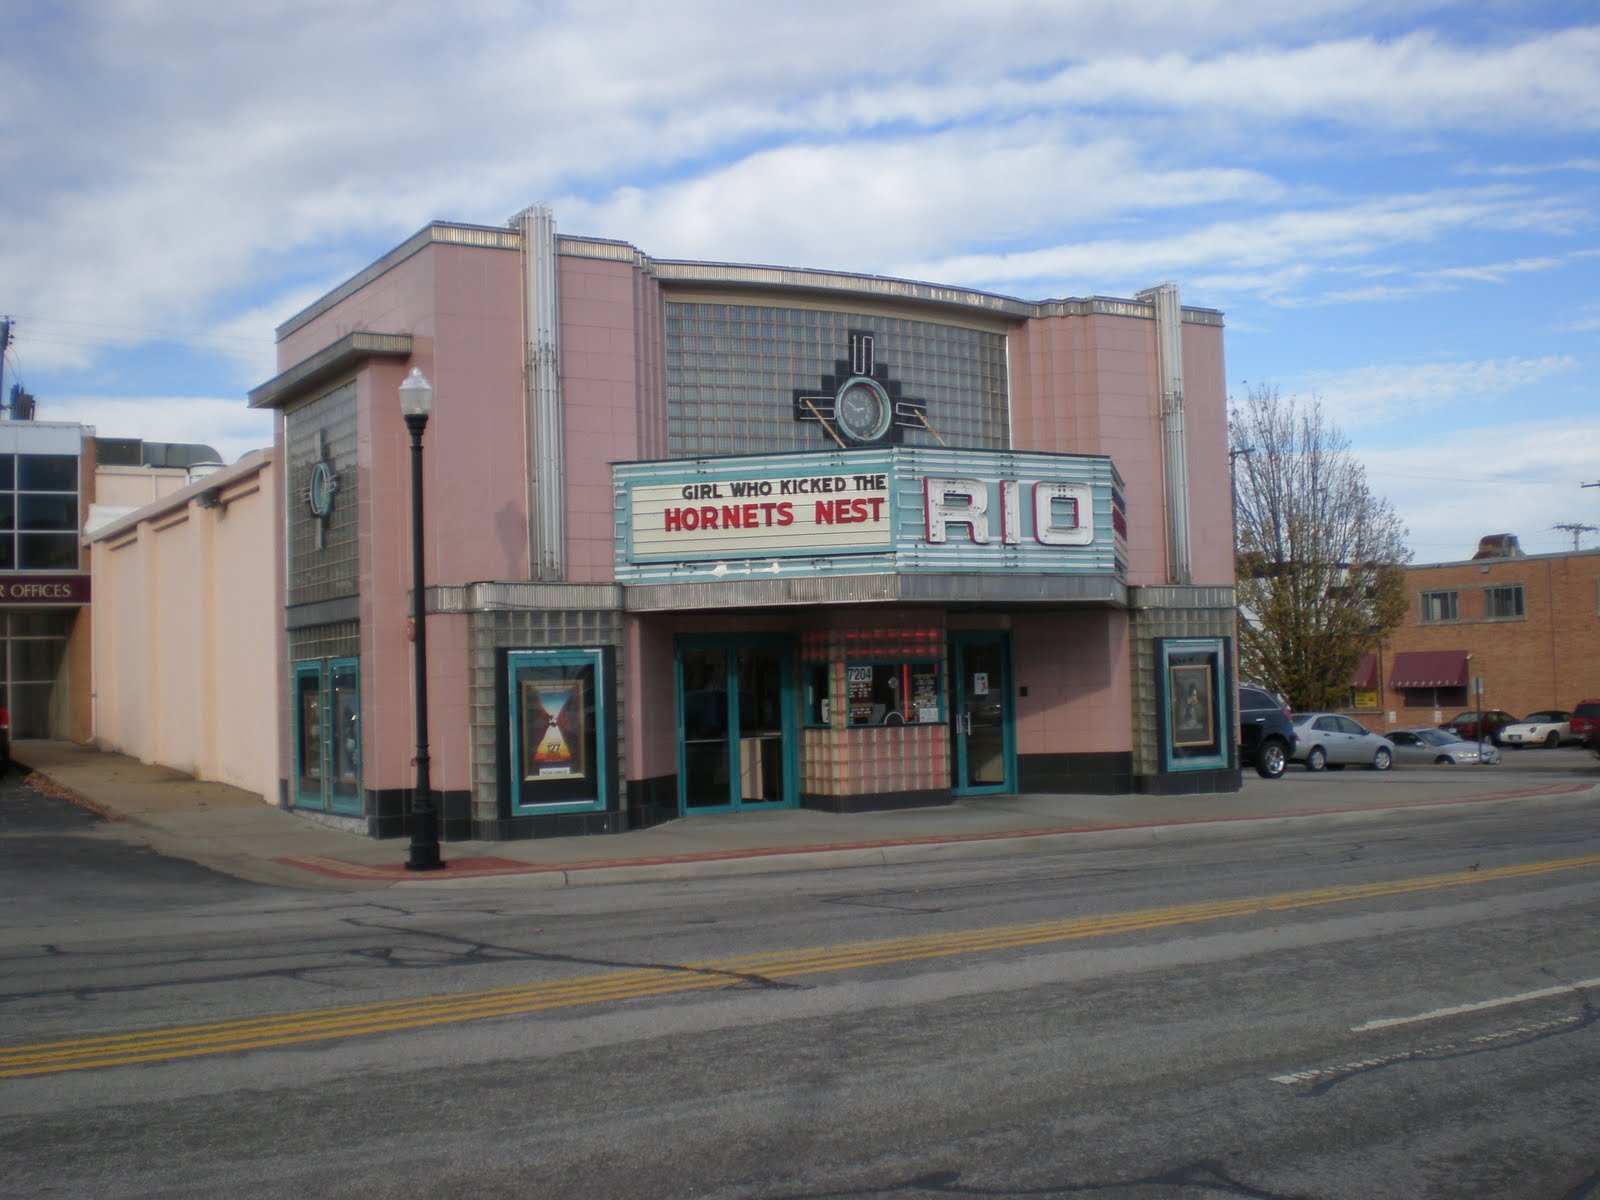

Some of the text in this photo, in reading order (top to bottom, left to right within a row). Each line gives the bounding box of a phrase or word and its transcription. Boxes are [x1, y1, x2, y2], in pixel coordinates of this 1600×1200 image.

[682, 474, 886, 500] GIRL WHO KICKED THE
[664, 497, 885, 532] HORNETS NEST
[922, 475, 1094, 547] RIO
[10, 584, 72, 598] OFFICES
[848, 668, 872, 681] 7204
